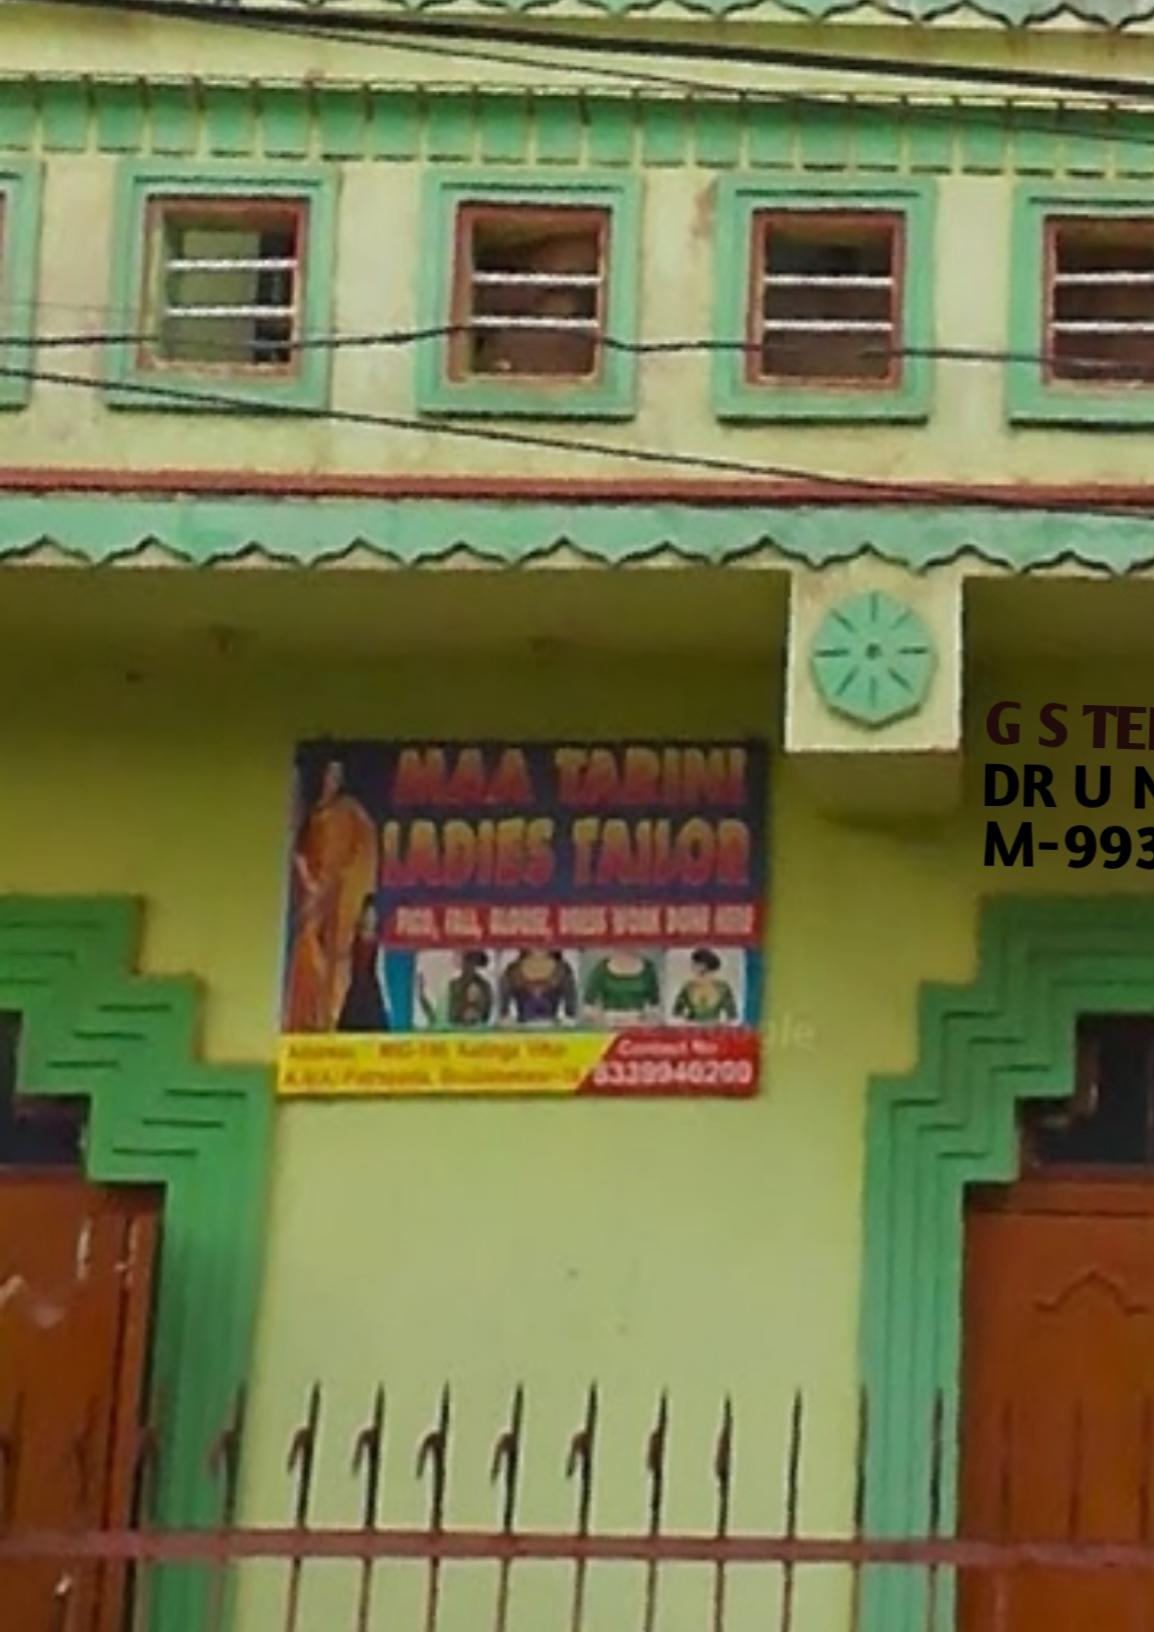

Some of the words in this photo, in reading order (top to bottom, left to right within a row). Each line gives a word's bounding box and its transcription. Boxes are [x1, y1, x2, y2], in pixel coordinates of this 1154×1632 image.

[391, 747, 535, 807] MAA
[555, 747, 747, 807] TARINI
[381, 818, 556, 887] LADIES
[571, 817, 751, 887] TAILOR
